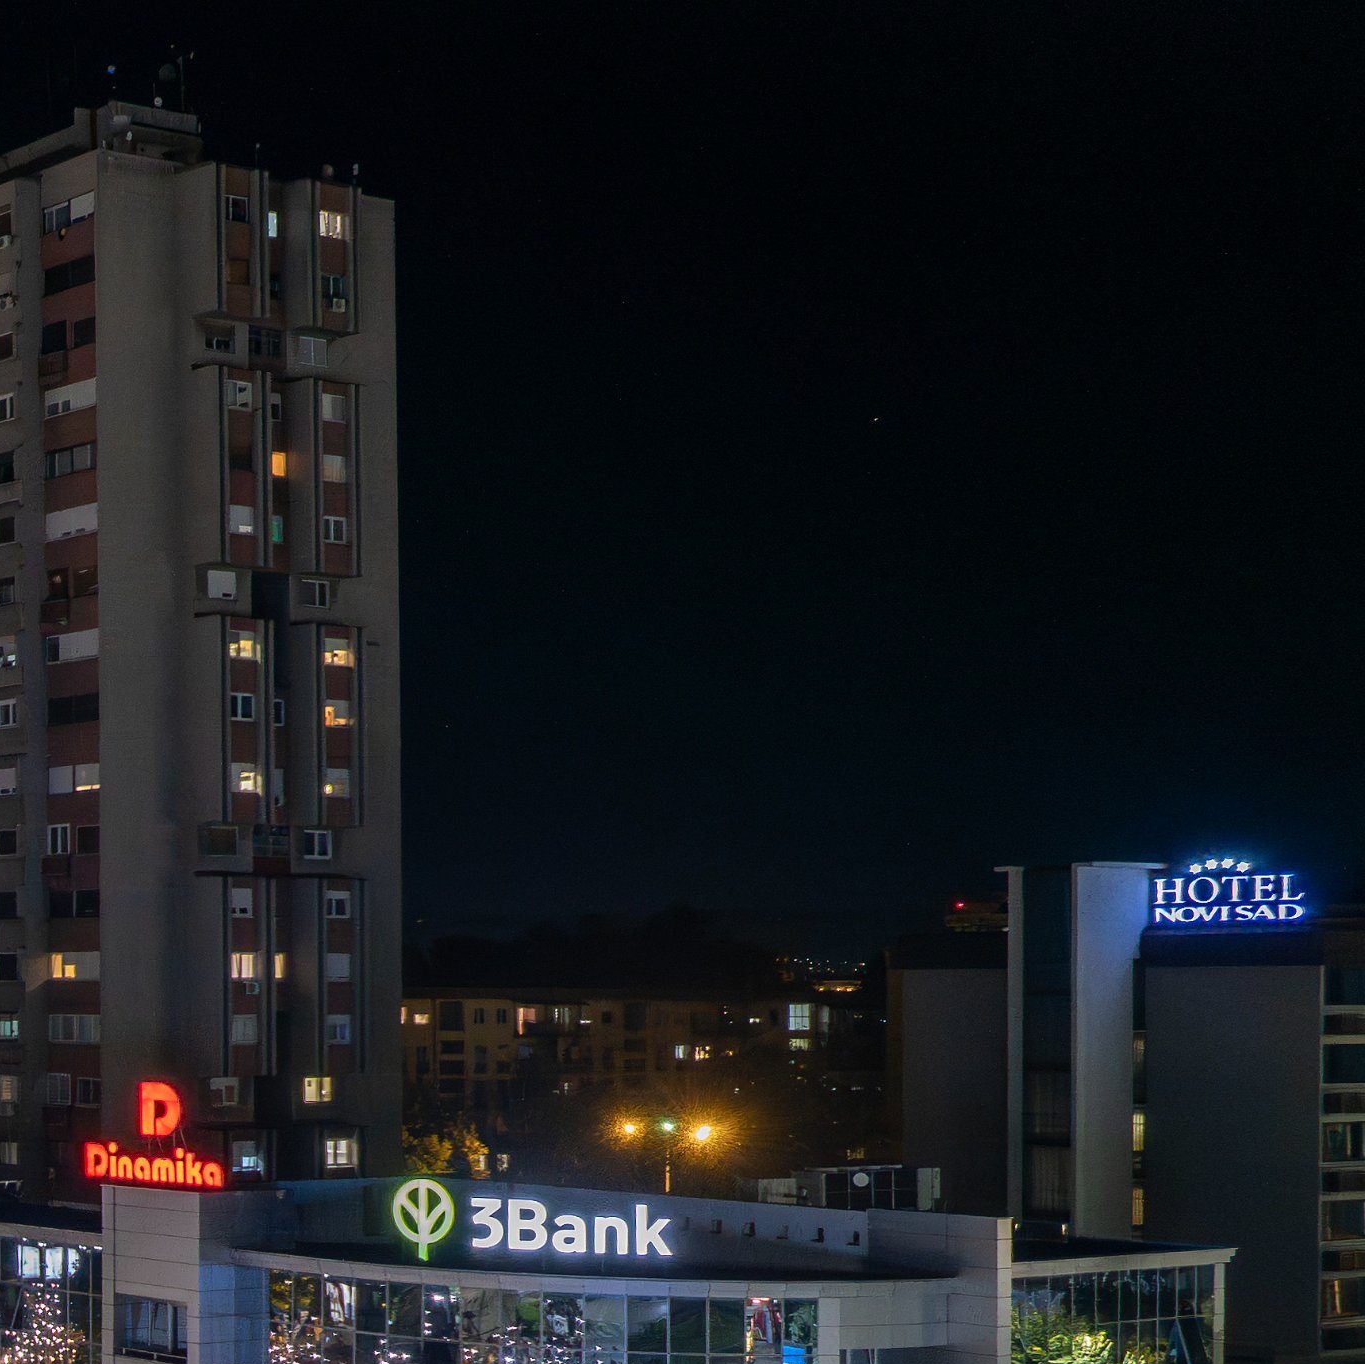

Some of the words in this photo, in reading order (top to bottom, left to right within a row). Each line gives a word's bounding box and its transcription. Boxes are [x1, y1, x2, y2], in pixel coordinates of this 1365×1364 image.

[1153, 873, 1305, 905] HOTEL
[1154, 906, 1231, 923] NOVI
[1235, 904, 1305, 921] SAD
[84, 1141, 224, 1188] Dinamika
[470, 1197, 673, 1257] 3Bank
